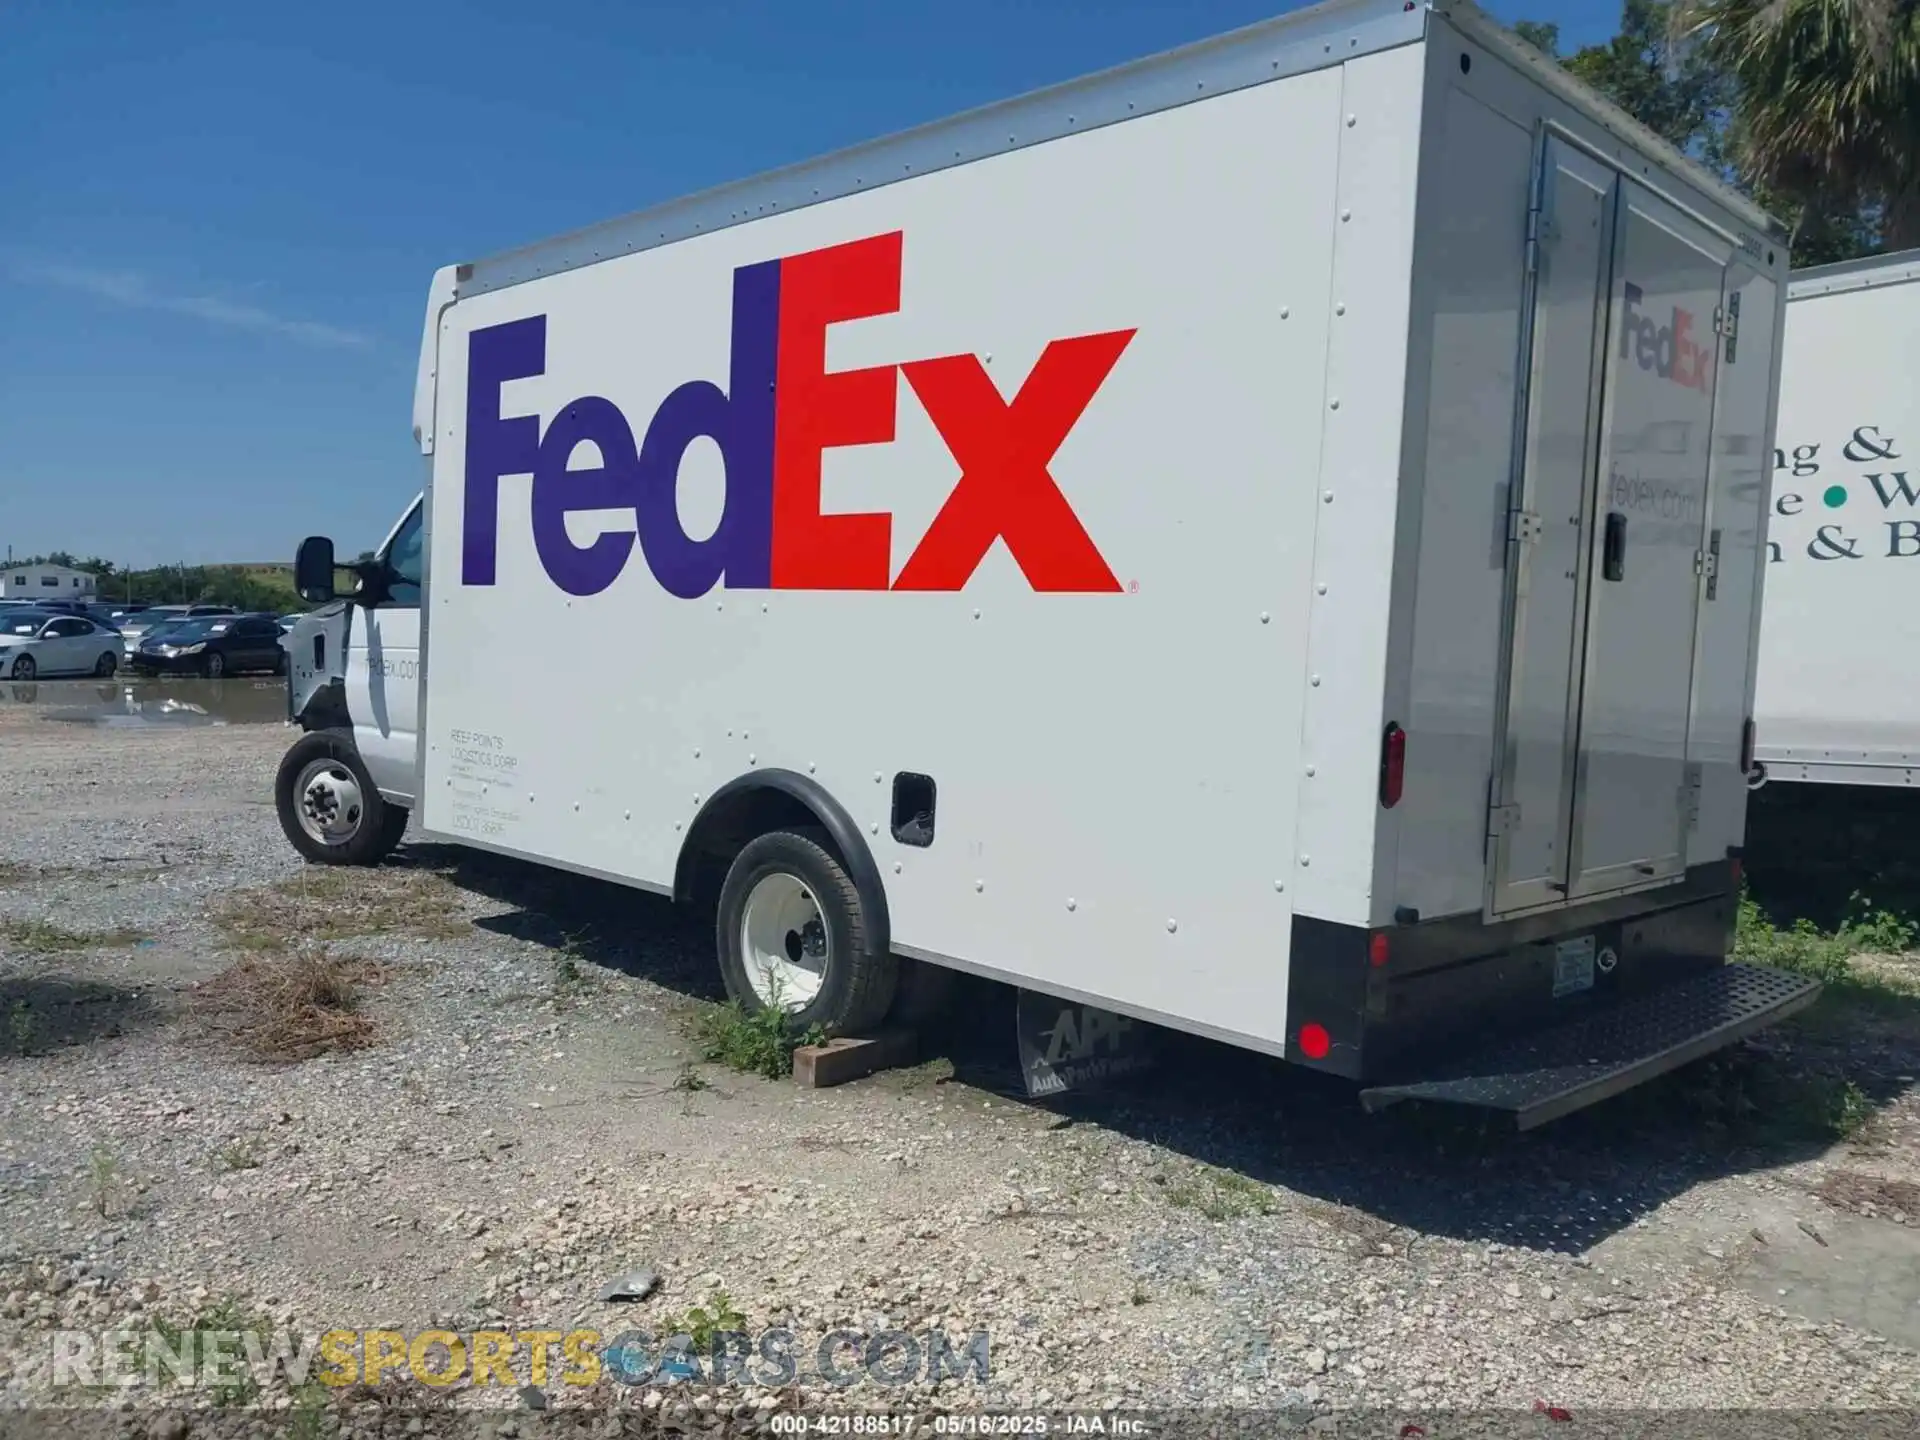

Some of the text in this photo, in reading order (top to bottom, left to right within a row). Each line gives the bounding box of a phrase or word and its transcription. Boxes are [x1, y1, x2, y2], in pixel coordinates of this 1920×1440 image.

[1620, 281, 1709, 394] FedEx
[462, 230, 1138, 599] FedEx
[1843, 426, 1902, 462] &
[1807, 525, 1864, 561] &
